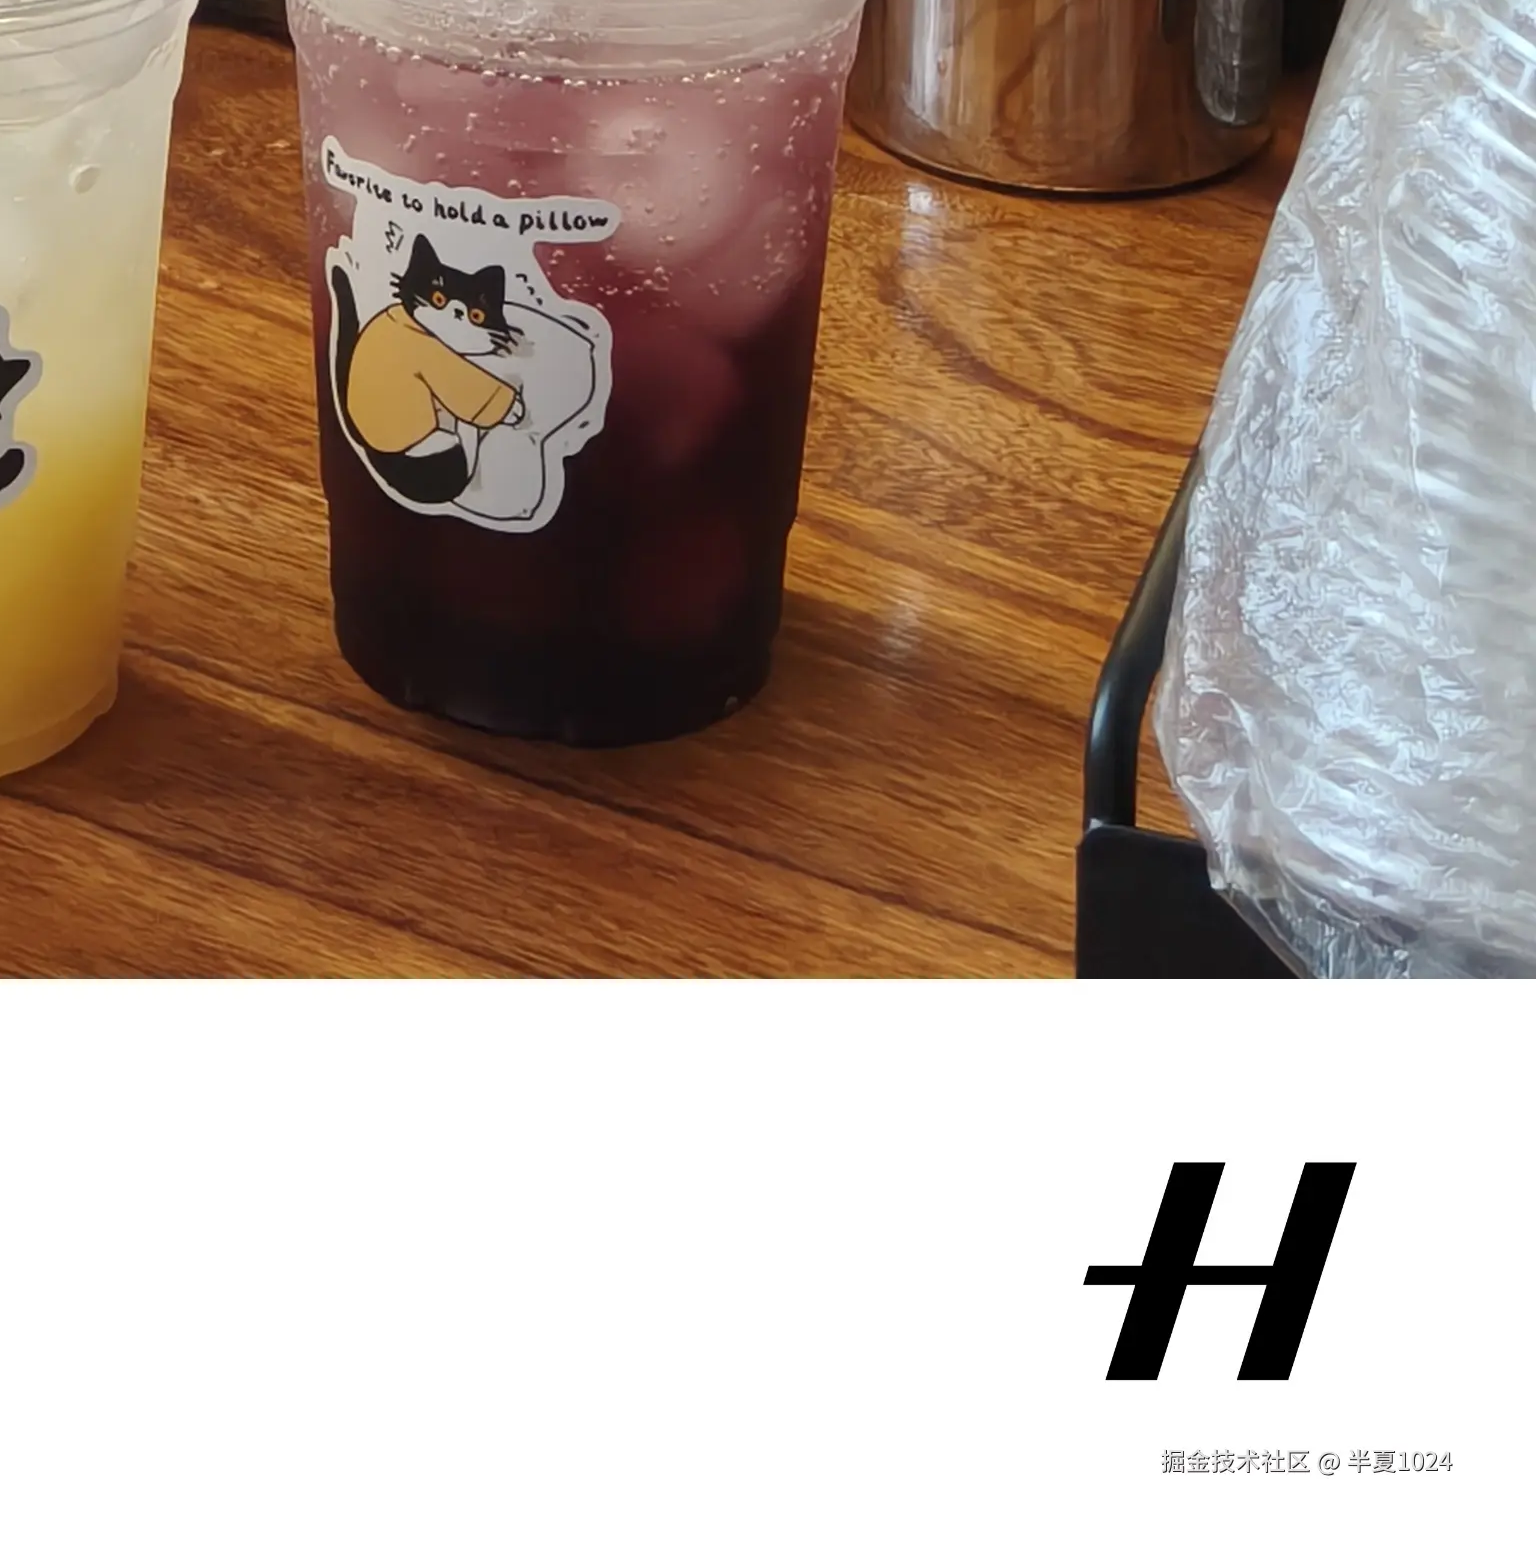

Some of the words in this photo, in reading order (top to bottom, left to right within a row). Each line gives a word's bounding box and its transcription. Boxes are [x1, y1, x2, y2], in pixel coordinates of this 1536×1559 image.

[326, 149, 393, 203] Favorite
[401, 193, 424, 214] to
[433, 197, 484, 227] hold
[492, 211, 510, 229] a
[519, 205, 609, 235] pillow
